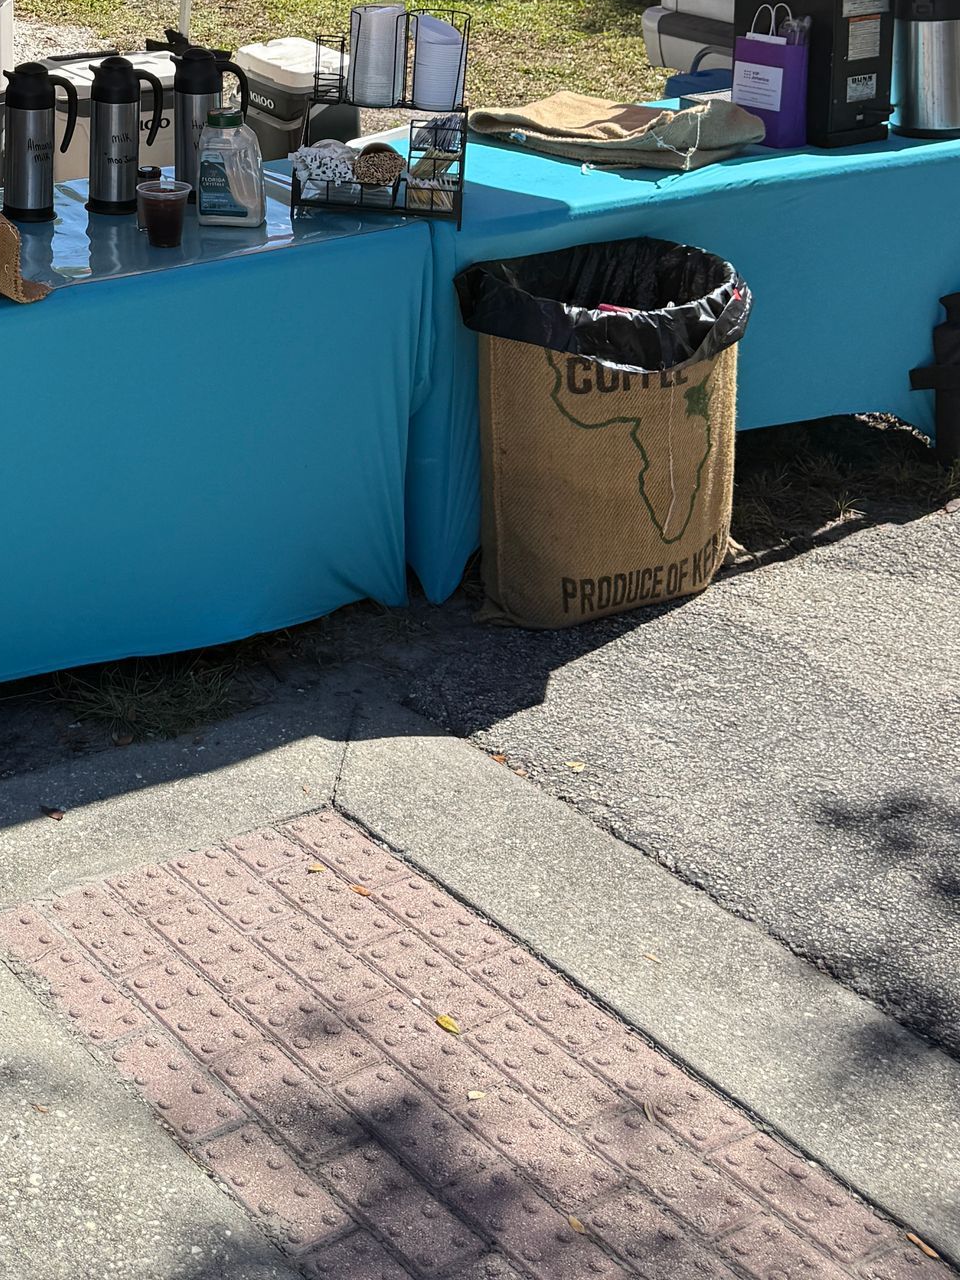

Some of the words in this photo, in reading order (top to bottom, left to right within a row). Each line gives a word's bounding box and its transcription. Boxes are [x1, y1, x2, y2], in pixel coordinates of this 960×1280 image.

[250, 91, 275, 109] IGLOO
[561, 566, 664, 615] PRODUCE
[666, 558, 689, 596] OF
